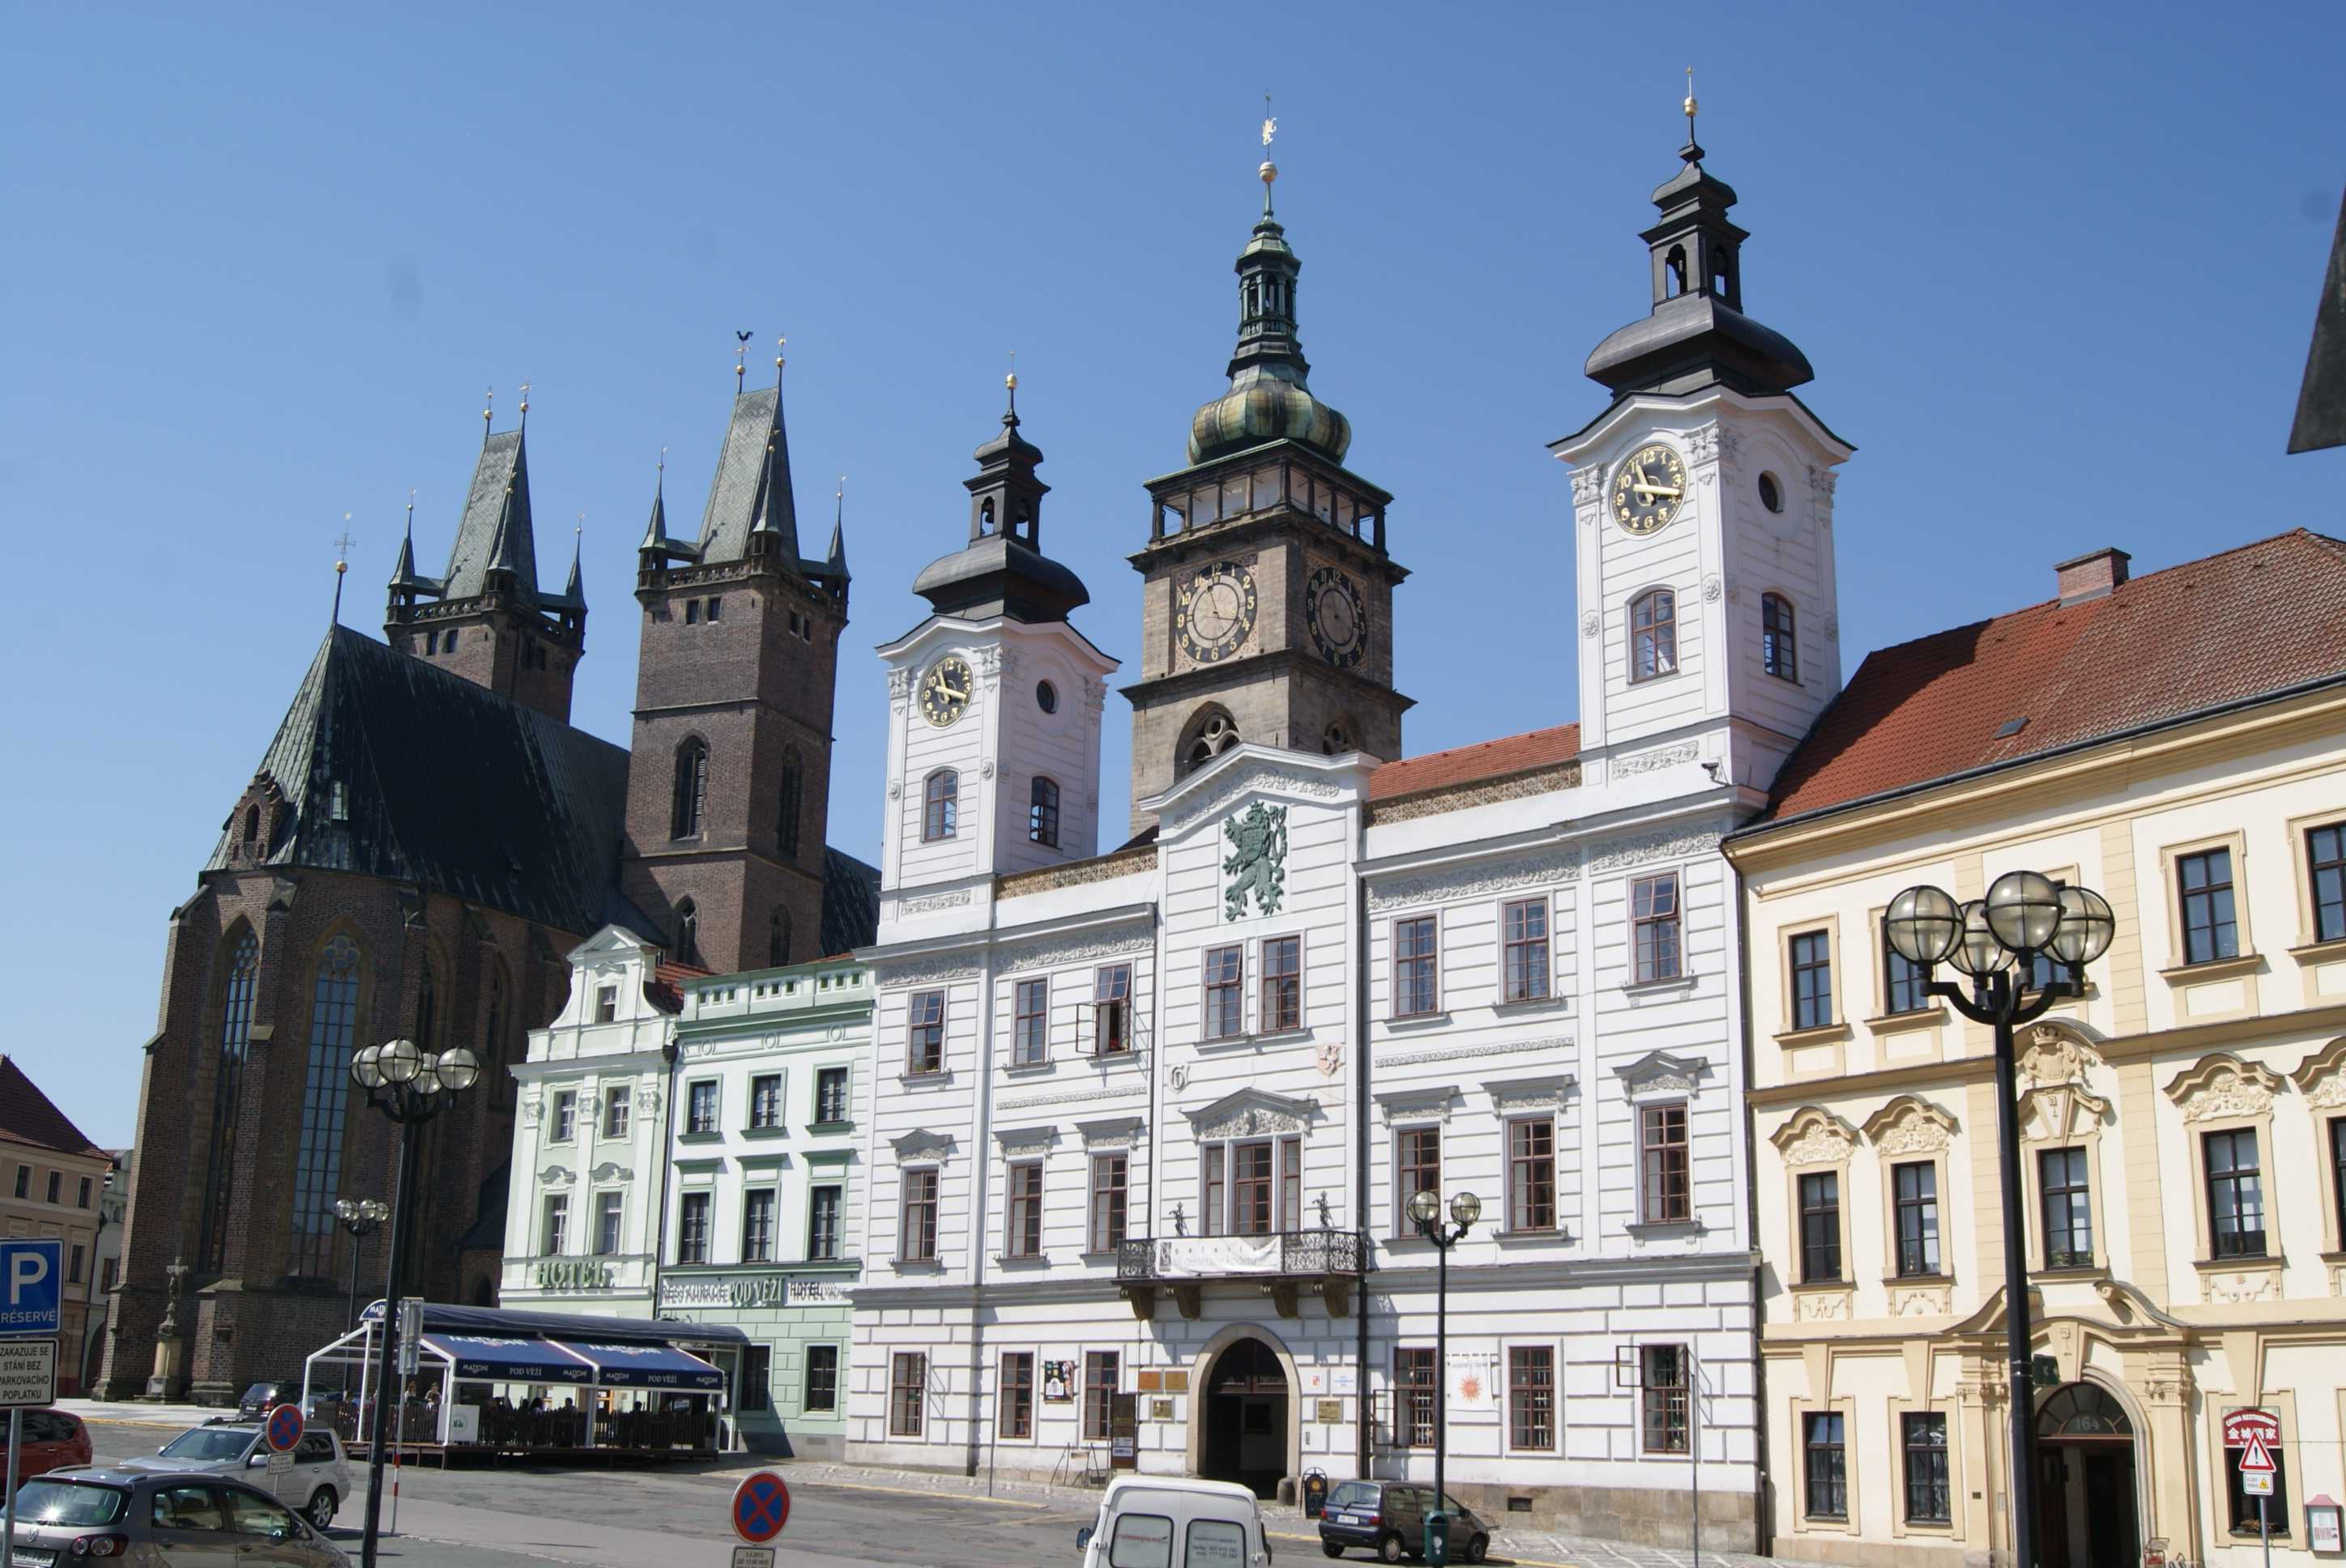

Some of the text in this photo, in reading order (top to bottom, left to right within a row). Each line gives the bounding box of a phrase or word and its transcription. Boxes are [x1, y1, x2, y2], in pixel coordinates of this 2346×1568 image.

[1643, 450, 1656, 465] 12
[1661, 452, 1667, 465] 1
[1669, 459, 1678, 472] 2
[1620, 475, 1632, 489] 10
[1672, 474, 1682, 488] 3
[1617, 492, 1625, 505] 9
[1620, 507, 1630, 521] 8
[1657, 507, 1667, 520] 5
[1631, 516, 1640, 529] 7
[1644, 515, 1654, 528] 6
[1211, 562, 1222, 577] 12
[1231, 564, 1235, 577] 1
[1320, 569, 1327, 582] 11
[1333, 569, 1341, 583] 12
[1194, 573, 1202, 588] 11
[1243, 576, 1251, 590] 2
[1311, 578, 1319, 591] 10
[1348, 582, 1351, 594] 1
[1181, 593, 1192, 606] 10
[1247, 596, 1255, 609] 3
[1356, 600, 1363, 614] 2
[1176, 614, 1184, 628] 9
[1241, 617, 1251, 631] 4
[1311, 622, 1317, 635] 8
[1359, 622, 1366, 635] 3
[1181, 634, 1189, 648] 8
[1230, 638, 1237, 651] 5
[1320, 641, 1327, 654] 7
[1194, 646, 1202, 660] 7
[1211, 647, 1219, 660] 6
[1356, 642, 1362, 656] 4
[1347, 654, 1353, 667] 5
[11, 1252, 49, 1304] P
[535, 1261, 608, 1286] HOTEL
[662, 1281, 728, 1301] RESTAURACE
[730, 1281, 751, 1302] POD
[754, 1277, 783, 1302] VĚŽÍ
[790, 1282, 822, 1297] HOTEL
[1, 1308, 58, 1323] RÉSERVÉ
[0, 1346, 49, 1357] ZAKAZUJE SE
[3, 1359, 41, 1371] STÁNÍ BEZ
[509, 1366, 525, 1376] POD
[648, 1375, 662, 1383] POD
[2, 1389, 42, 1400] POPLATKU
[2075, 1416, 2101, 1430] 164
